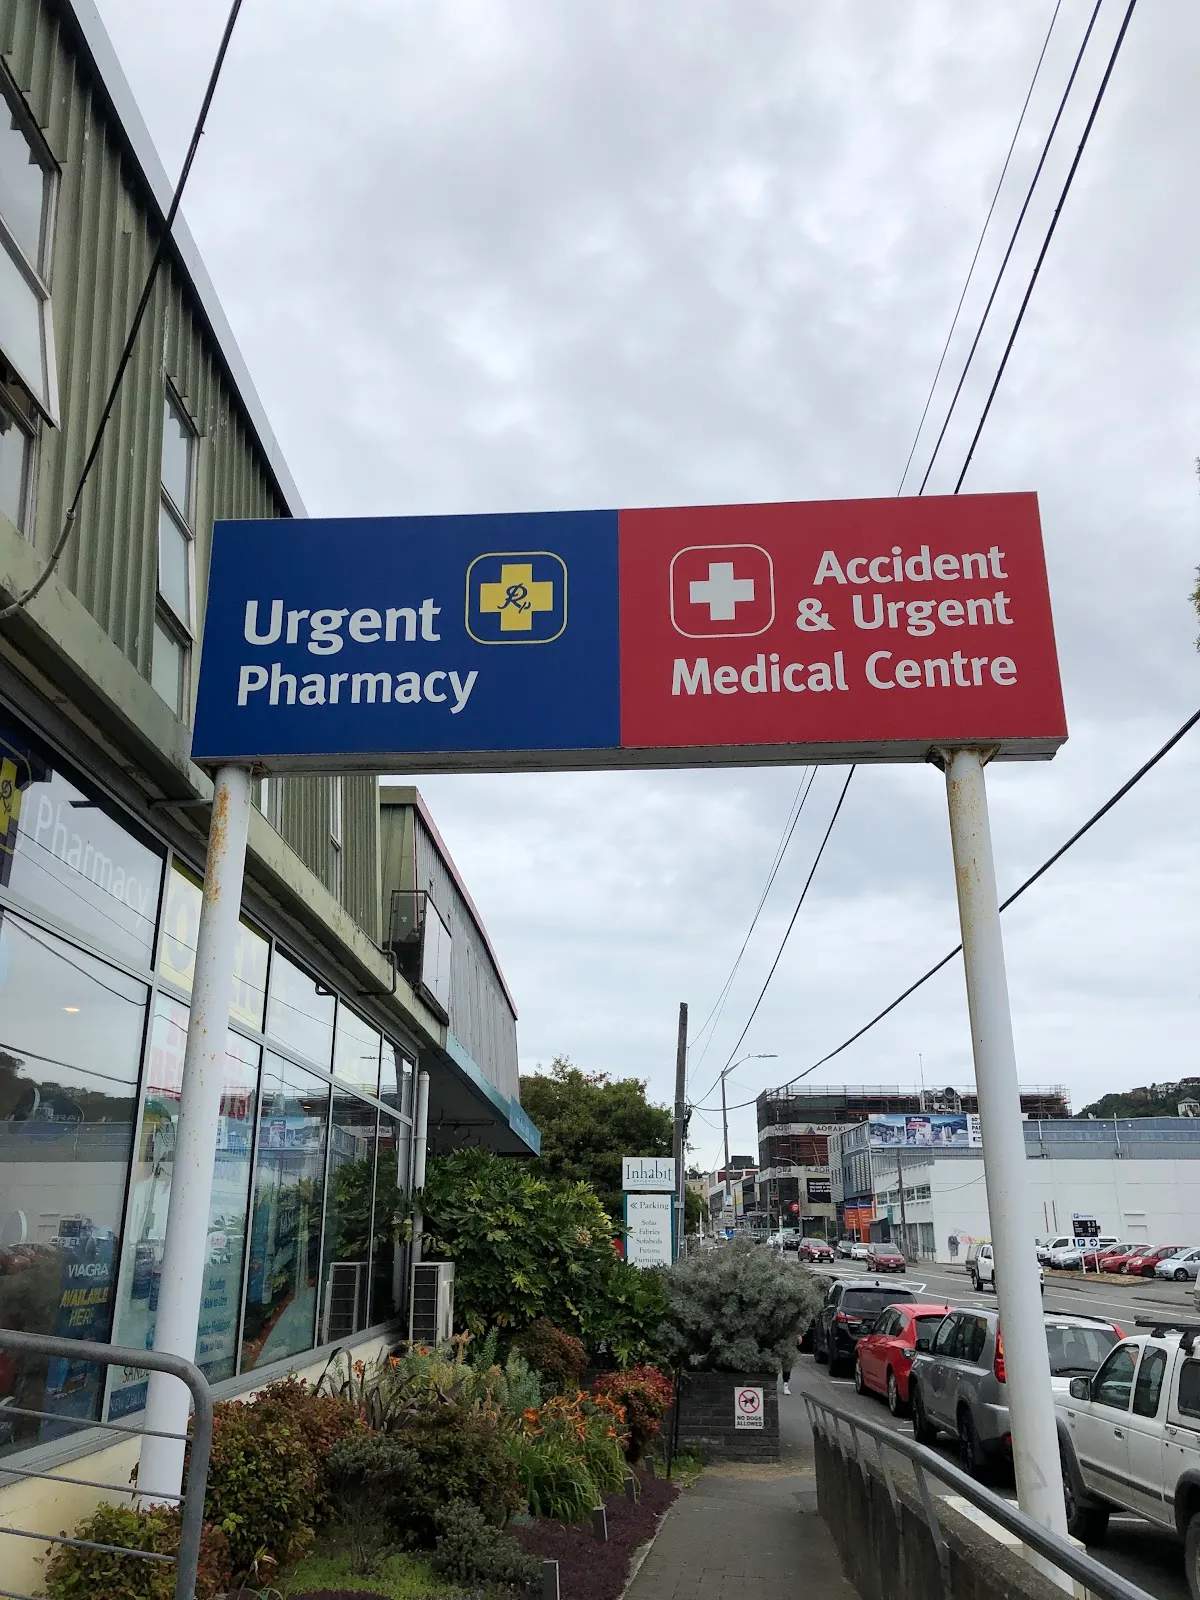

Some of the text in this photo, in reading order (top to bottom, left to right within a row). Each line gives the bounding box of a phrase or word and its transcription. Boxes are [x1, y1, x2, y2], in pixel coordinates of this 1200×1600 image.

[813, 545, 1008, 585] Accident
[245, 599, 441, 655] Urgent
[796, 591, 1013, 636] & Urgent
[238, 663, 478, 714] Pharmacy
[672, 651, 1017, 695] Medical Centre
[35, 794, 149, 928] Pharmacy
[626, 1160, 672, 1181] Inhabit
[640, 1201, 669, 1211] Parking
[68, 1263, 109, 1277] VIAGRA
